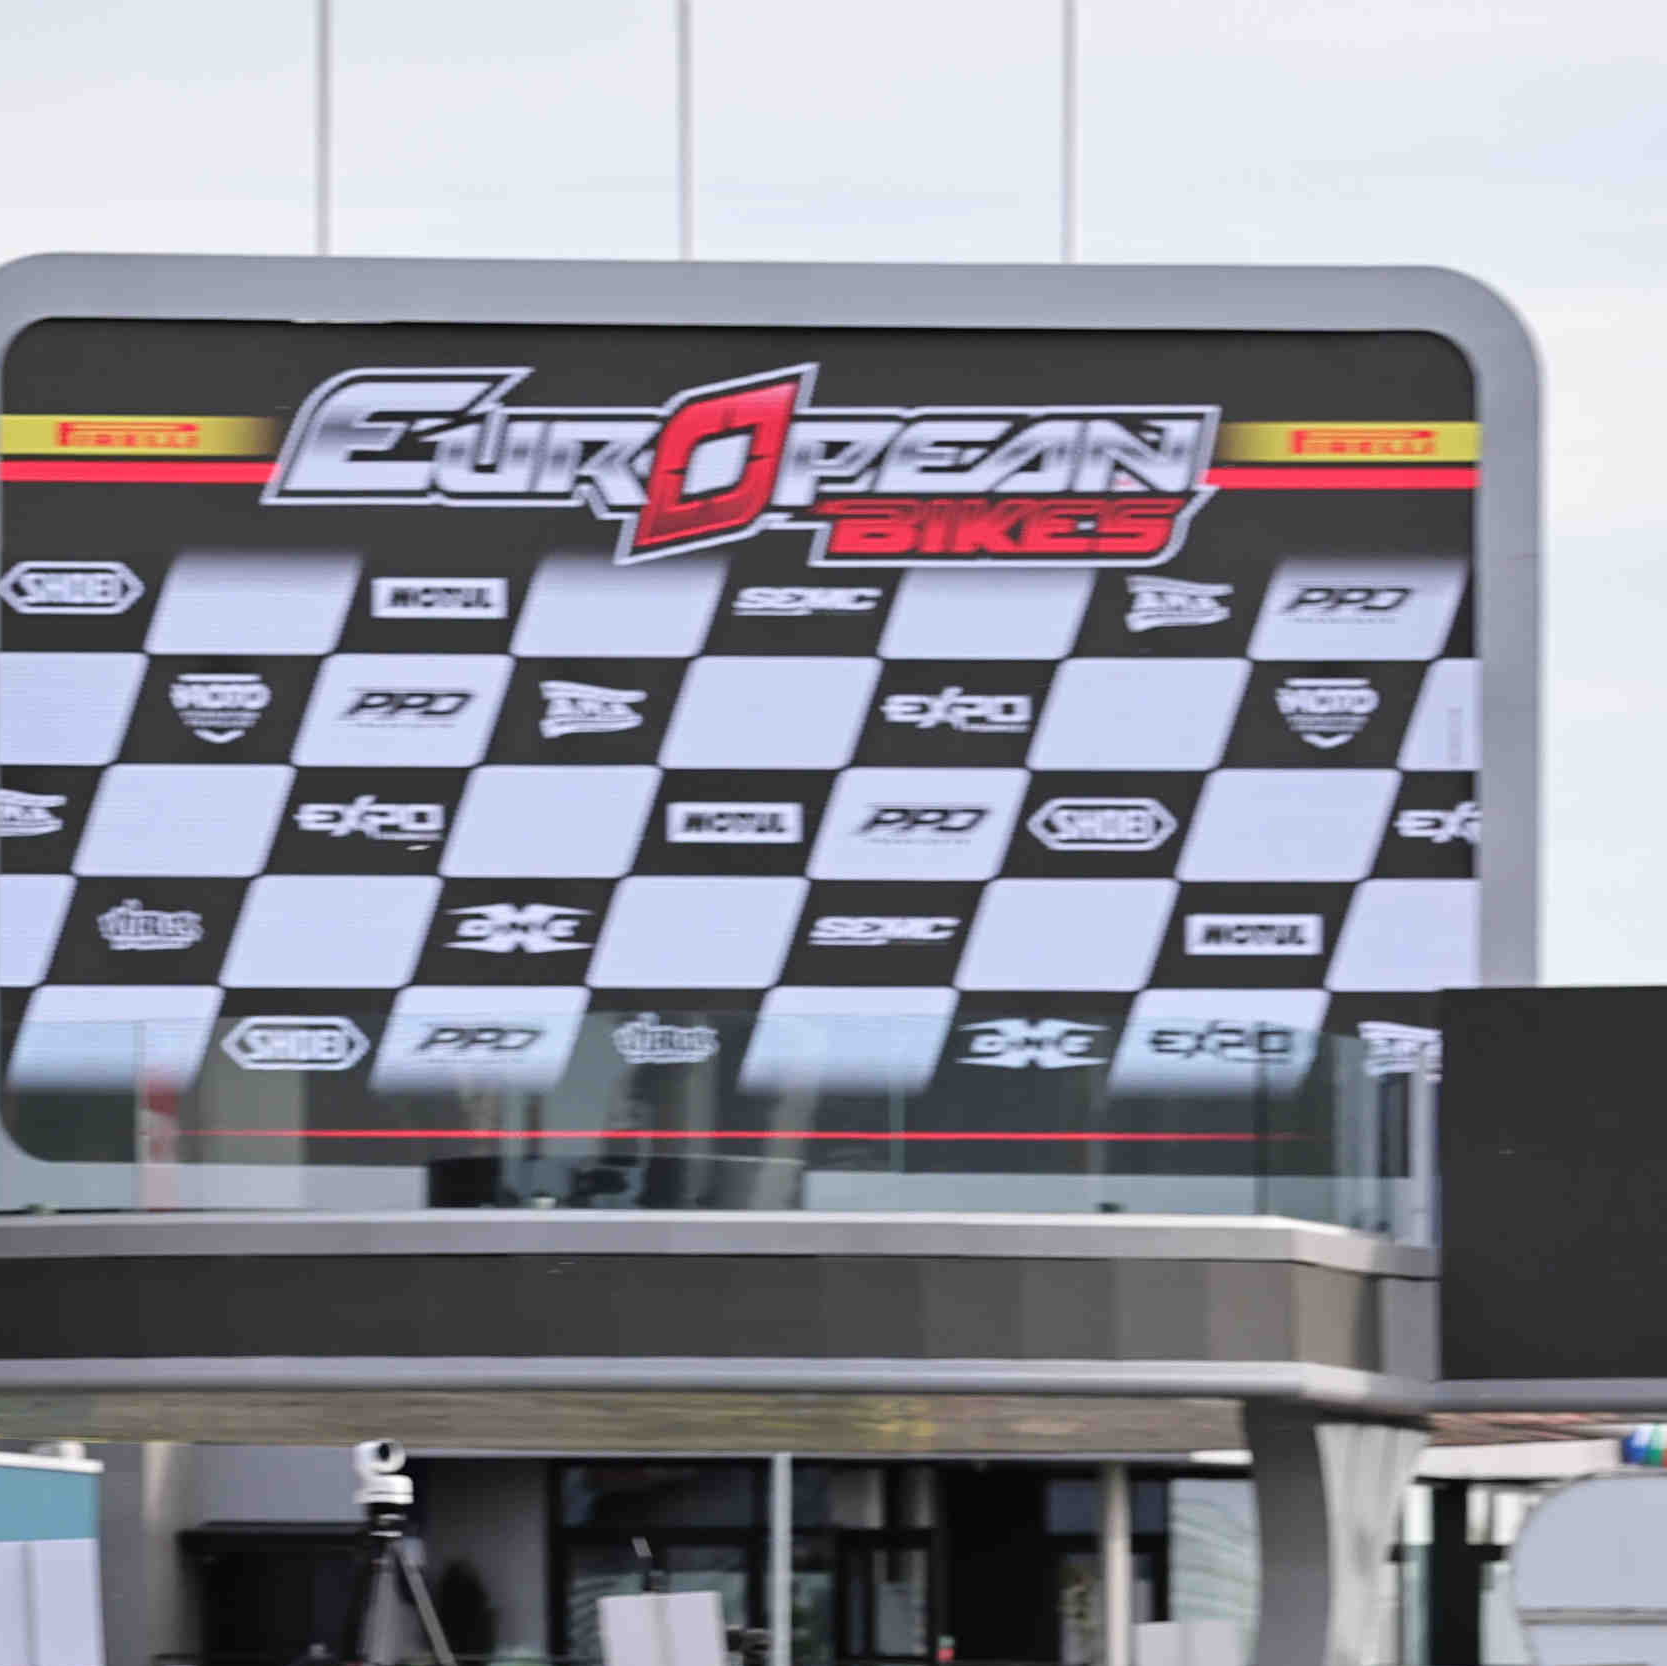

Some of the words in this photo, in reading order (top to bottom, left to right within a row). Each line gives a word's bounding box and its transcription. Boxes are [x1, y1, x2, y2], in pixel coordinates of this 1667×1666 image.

[55, 421, 201, 448] PIRELLI
[1288, 428, 1436, 456] PIRELLI
[267, 365, 1220, 562] EUROPEAN
[813, 498, 1187, 555] BIKES
[390, 586, 492, 609] MOTUL
[683, 811, 787, 833] MOTUL
[1202, 924, 1308, 946] MOTUL
